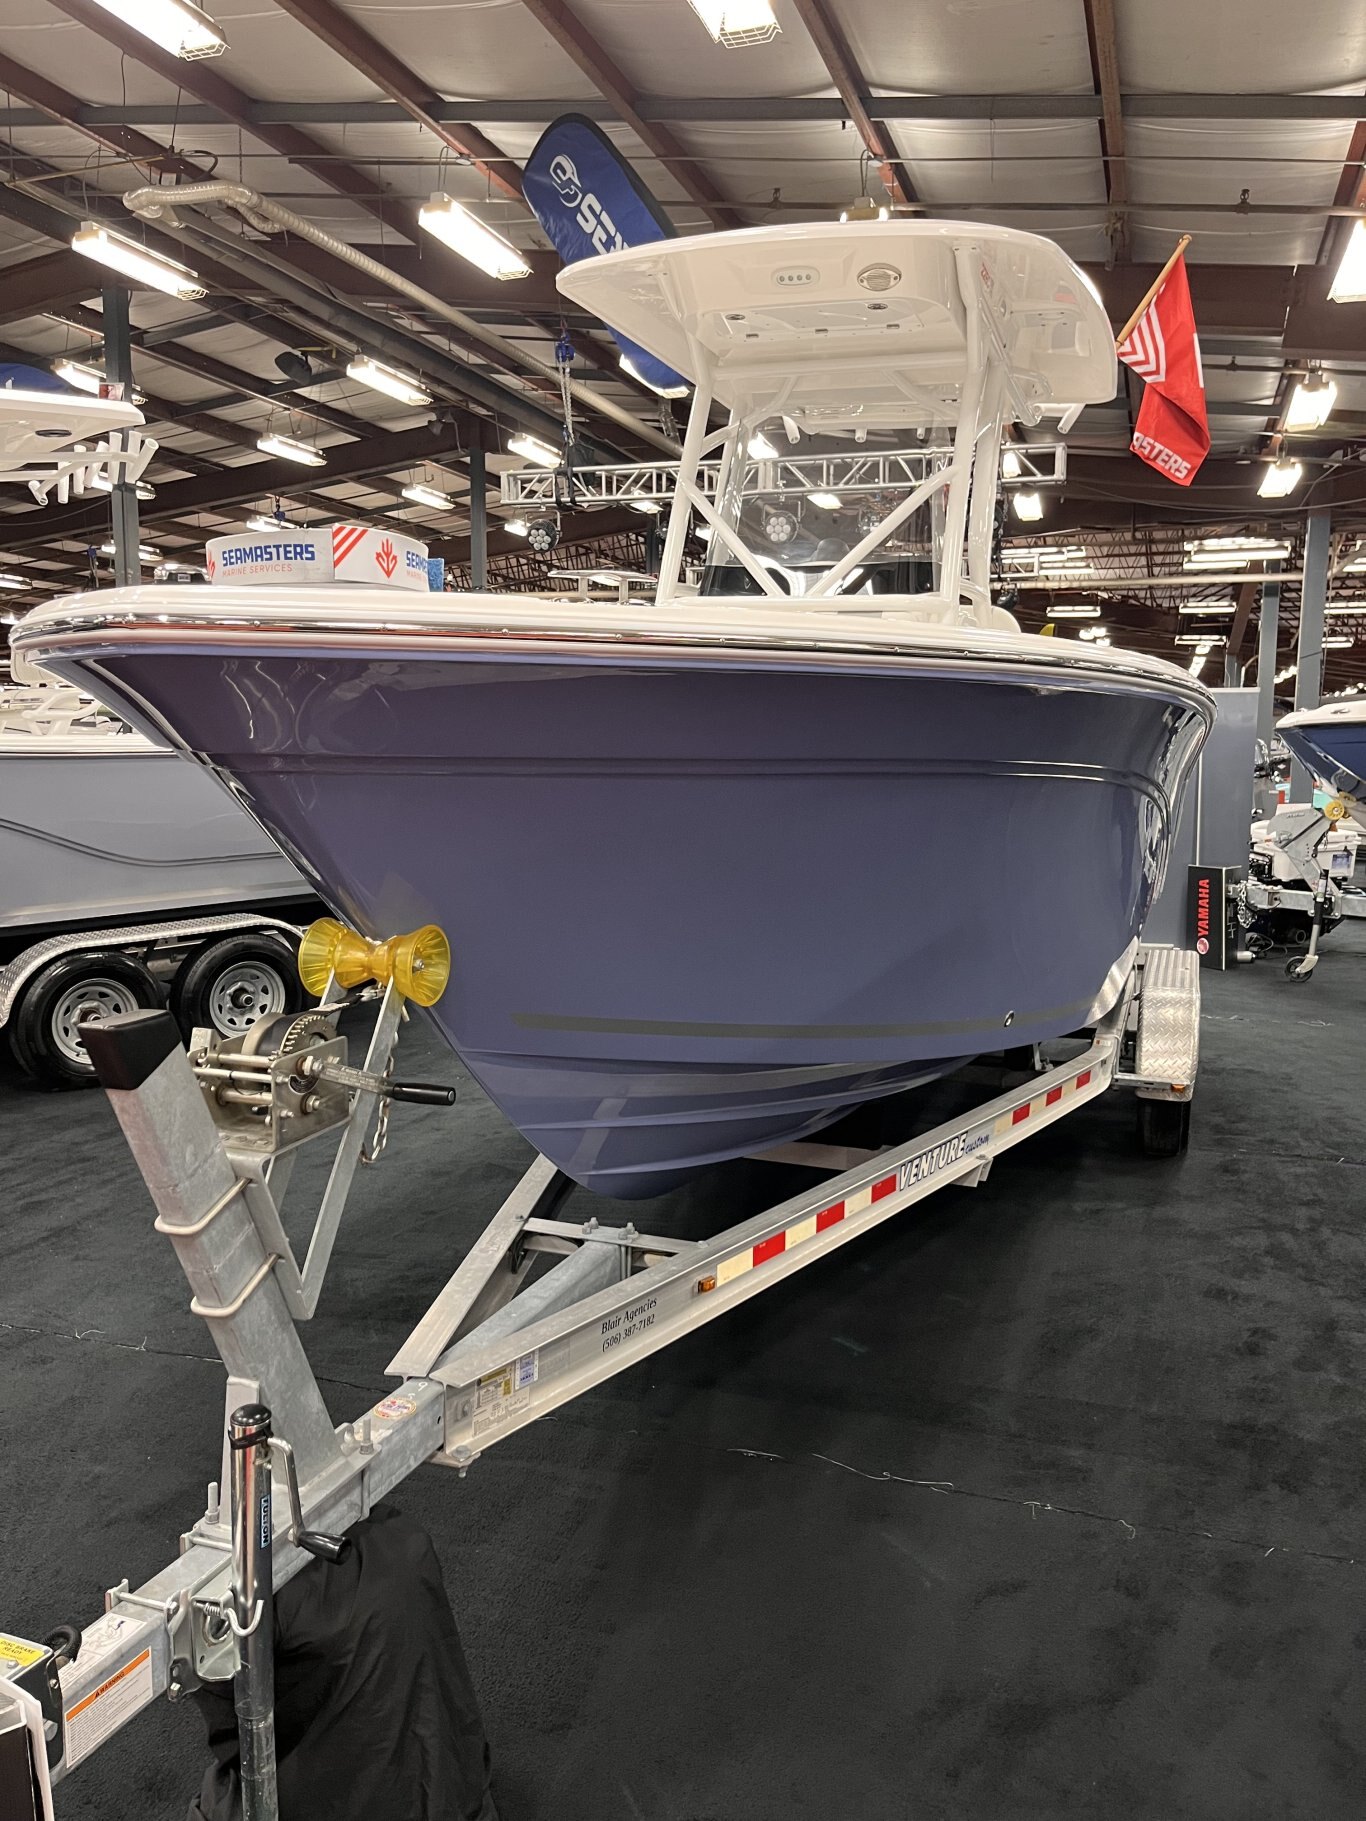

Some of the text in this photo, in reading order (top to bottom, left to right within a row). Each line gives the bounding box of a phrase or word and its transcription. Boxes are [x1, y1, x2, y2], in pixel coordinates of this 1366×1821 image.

[222, 543, 315, 567] SEAMASTERS
[222, 564, 293, 577] MARINE SERVICES
[1197, 879, 1210, 937] YAMAHA
[899, 1131, 968, 1192] VENTURE
[601, 1298, 658, 1335] Blair Agencies
[100, 1671, 125, 1694] WARNING
